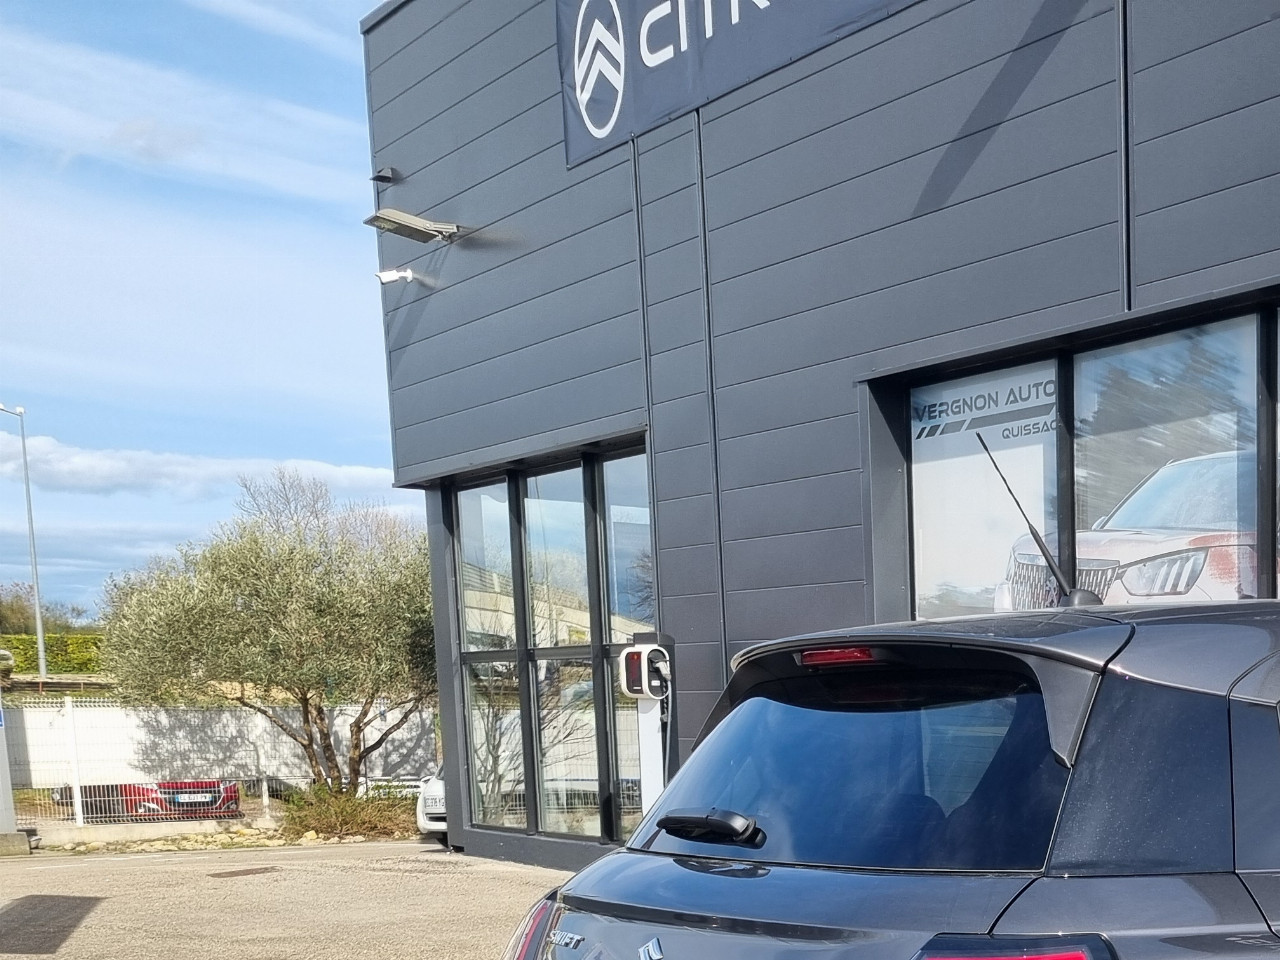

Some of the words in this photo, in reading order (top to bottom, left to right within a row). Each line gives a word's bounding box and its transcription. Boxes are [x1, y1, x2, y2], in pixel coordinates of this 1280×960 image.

[914, 391, 999, 423] VERGNON
[1005, 379, 1056, 406] AUTO
[546, 930, 586, 950] SWIFT
